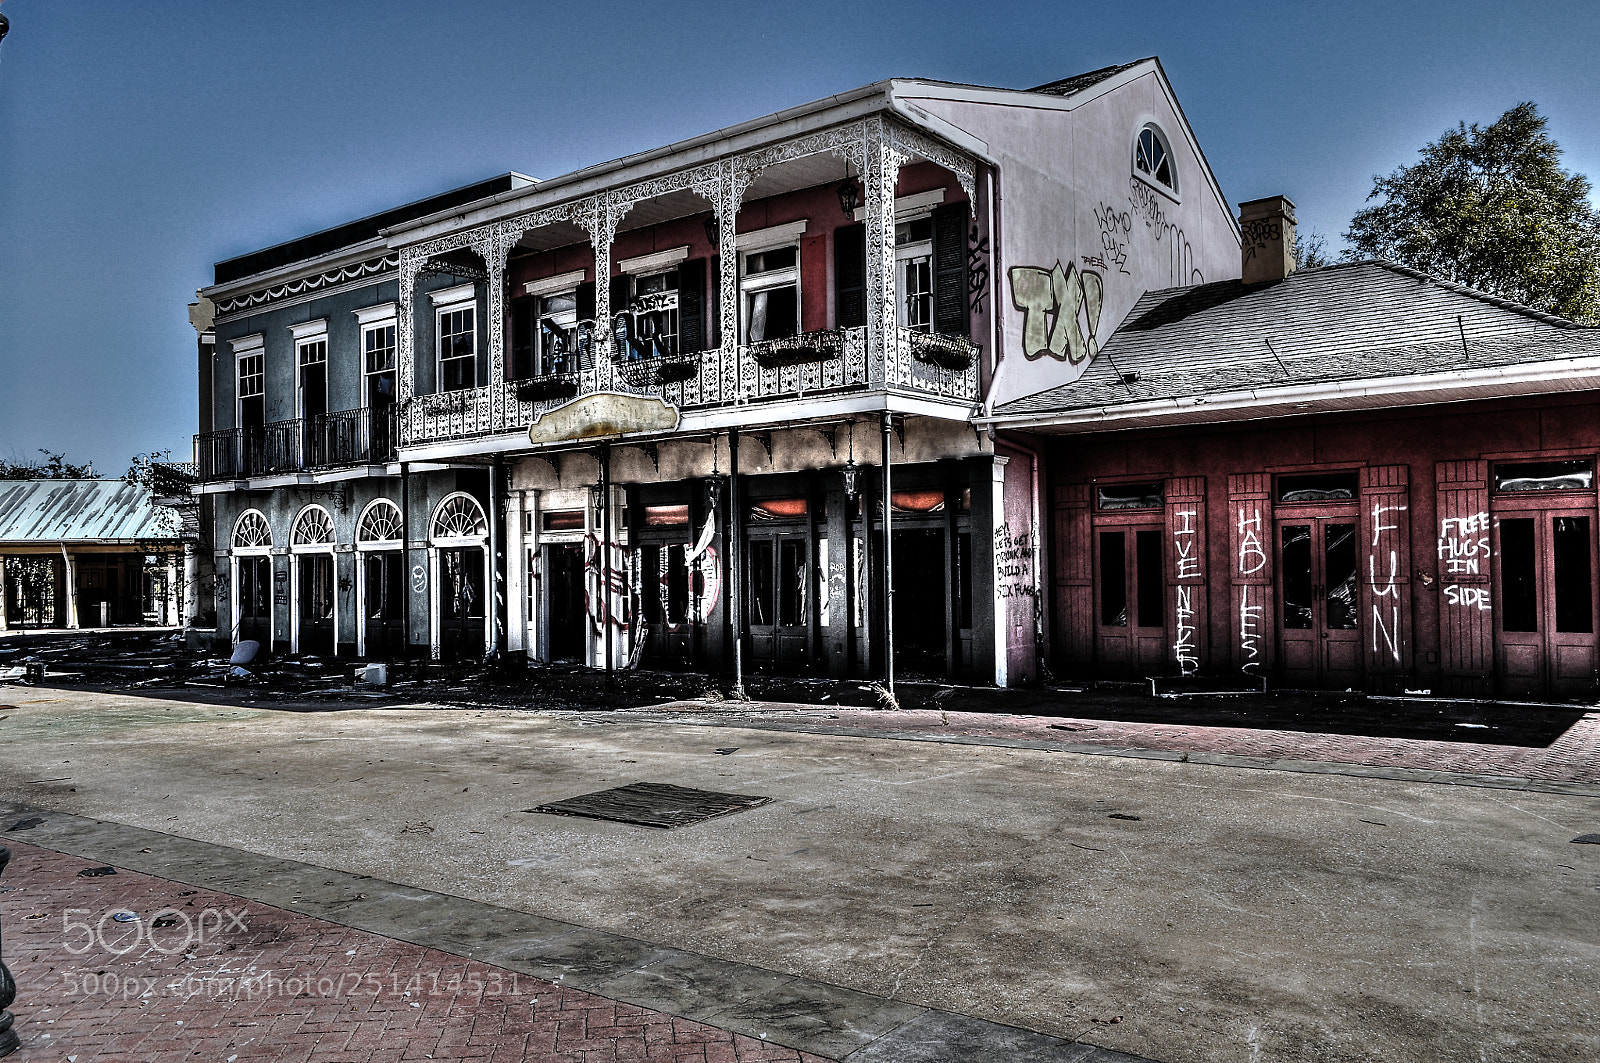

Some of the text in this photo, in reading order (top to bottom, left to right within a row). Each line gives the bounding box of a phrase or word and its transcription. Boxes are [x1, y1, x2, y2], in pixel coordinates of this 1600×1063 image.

[1441, 511, 1490, 538] FREE
[995, 533, 1028, 550] LETS GET
[1237, 509, 1266, 574] HAD
[1437, 537, 1491, 560] HUGS
[997, 564, 1028, 581] BUILD A
[1446, 559, 1478, 574] IN
[997, 584, 1013, 599] SIX
[1369, 504, 1407, 662] FUN
[1444, 585, 1491, 610] SIDE
